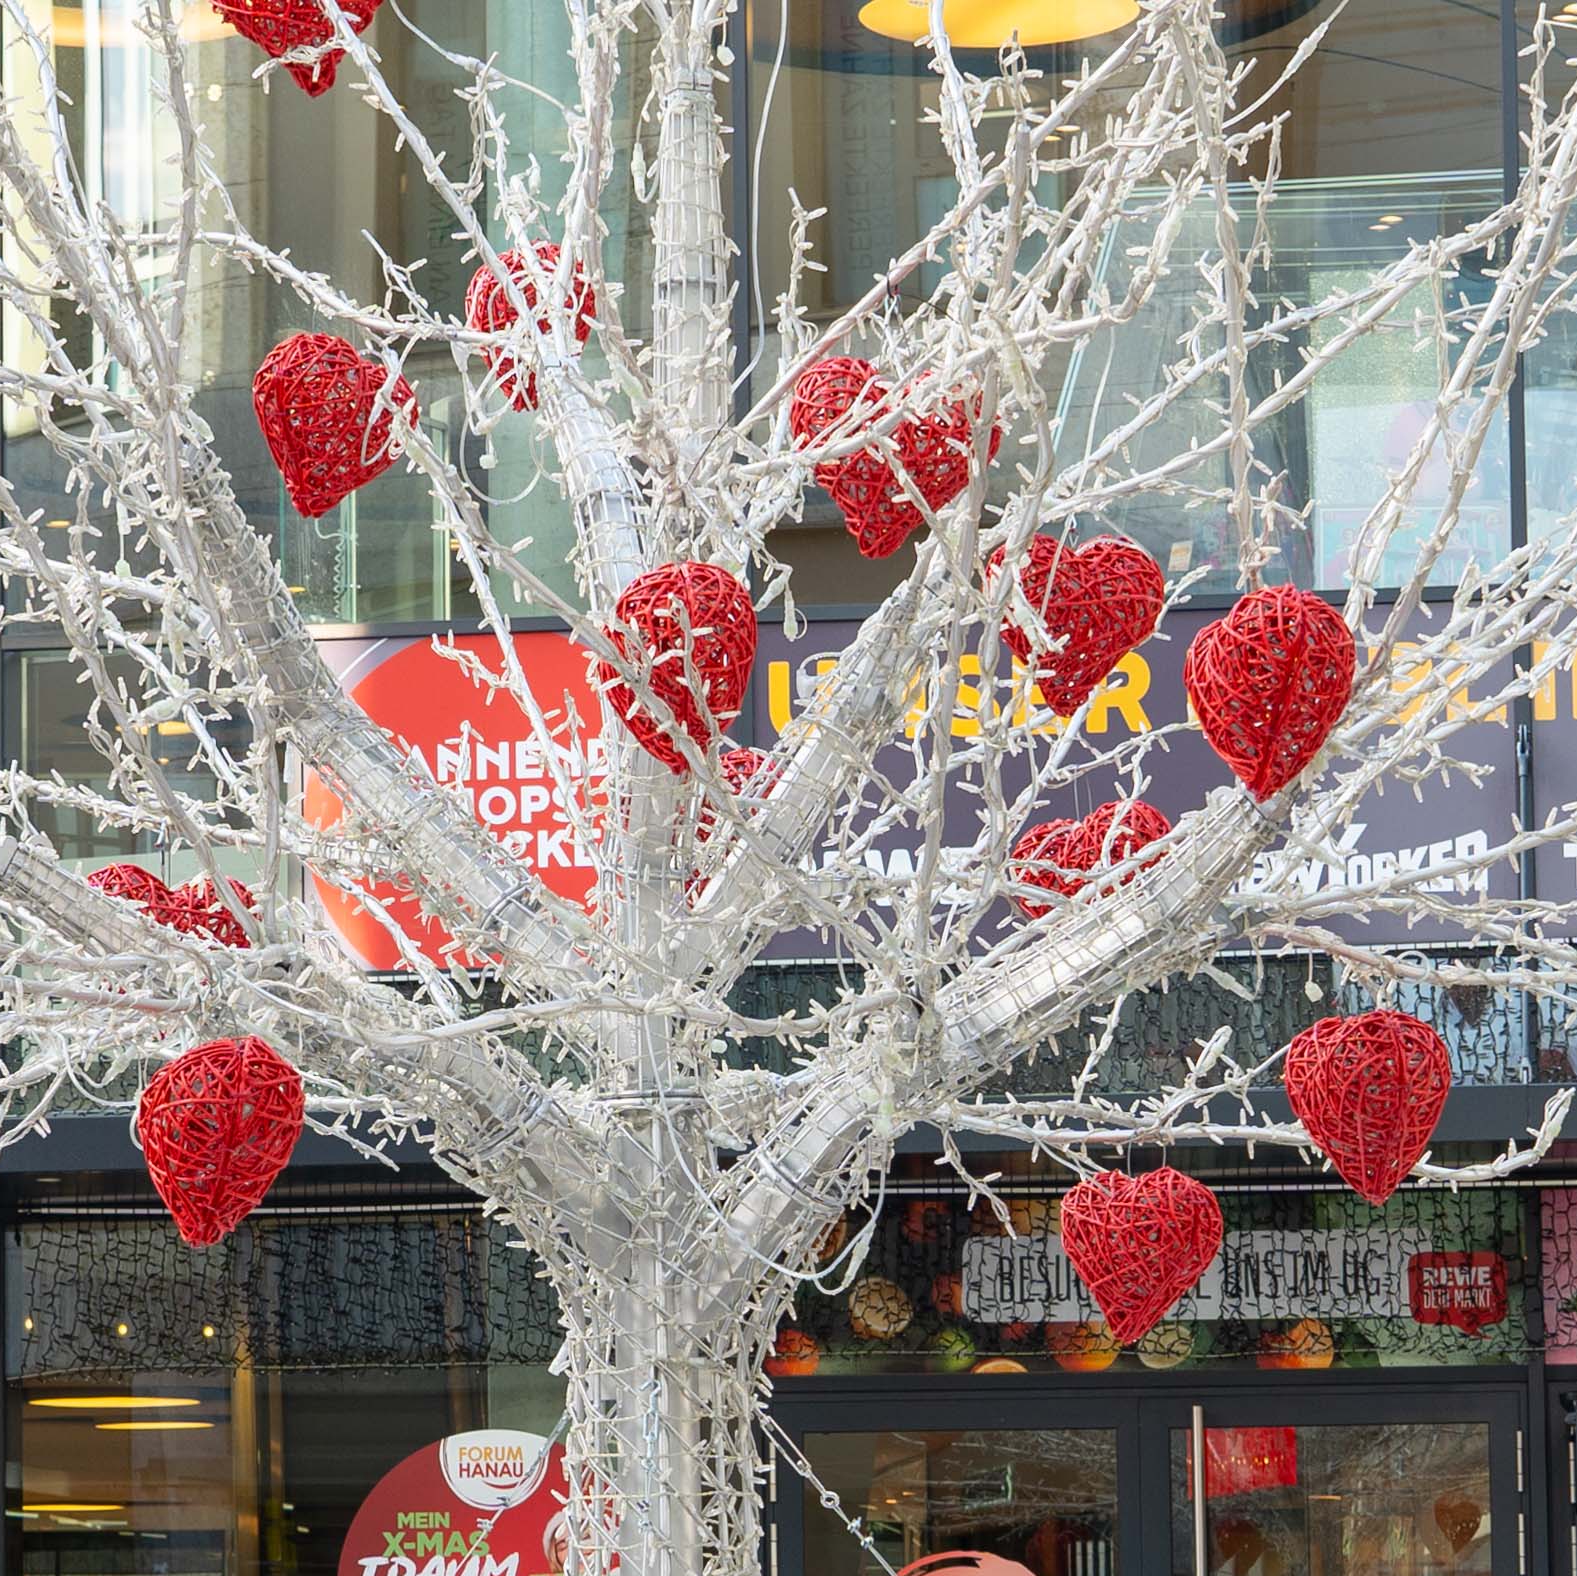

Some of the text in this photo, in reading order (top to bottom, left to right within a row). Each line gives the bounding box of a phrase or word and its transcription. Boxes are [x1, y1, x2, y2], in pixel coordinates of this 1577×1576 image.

[1423, 1266, 1491, 1287] REWE
[458, 1446, 523, 1461] FORUM
[458, 1462, 524, 1478] HANAU
[397, 1512, 450, 1528] MEIN
[382, 1531, 490, 1557] X-MAS
